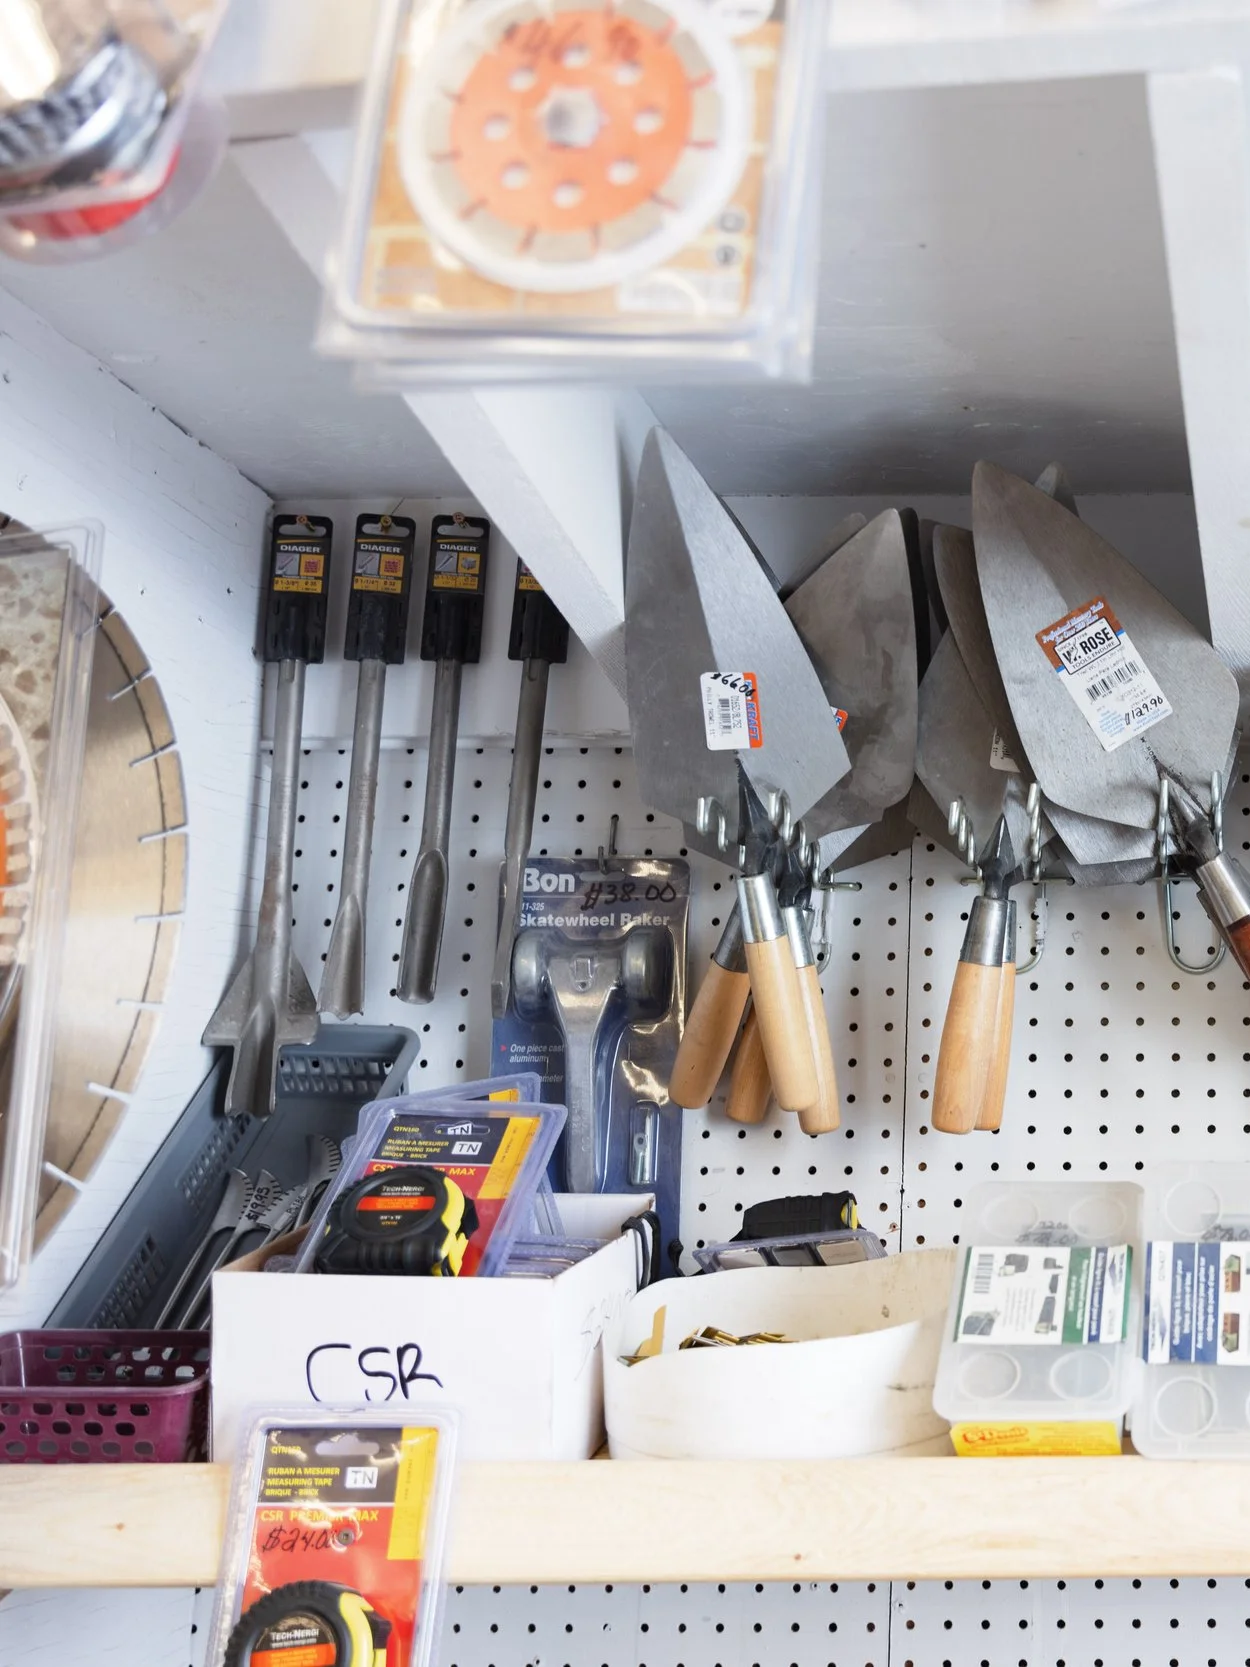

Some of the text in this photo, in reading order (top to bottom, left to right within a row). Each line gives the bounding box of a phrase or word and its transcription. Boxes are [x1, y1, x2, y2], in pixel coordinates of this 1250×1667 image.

[280, 544, 321, 553] DIAGER
[360, 543, 401, 553] DIAGER
[440, 543, 477, 552] DIAGER
[1078, 626, 1113, 655] ROSE
[1071, 639, 1116, 669] TOOLS ENDURE
[746, 701, 759, 740] KRAFT
[523, 867, 575, 893] Bon
[520, 913, 671, 927] Skatewheel Raker
[510, 1043, 526, 1053] One
[526, 1044, 547, 1054] piece
[383, 1144, 423, 1152] MEASURING
[417, 1139, 448, 1147] MESURER
[457, 1142, 478, 1153] TN
[448, 1166, 475, 1176] MAX
[306, 1343, 444, 1402] CSR
[268, 1467, 340, 1475] RUBAN A MESURER
[266, 1477, 333, 1486] MEASURING TAPE
[351, 1470, 374, 1484] TN
[265, 1488, 291, 1496] BRIQUE
[261, 1510, 284, 1521] CSR
[270, 1628, 319, 1640] TECH-NERGI
